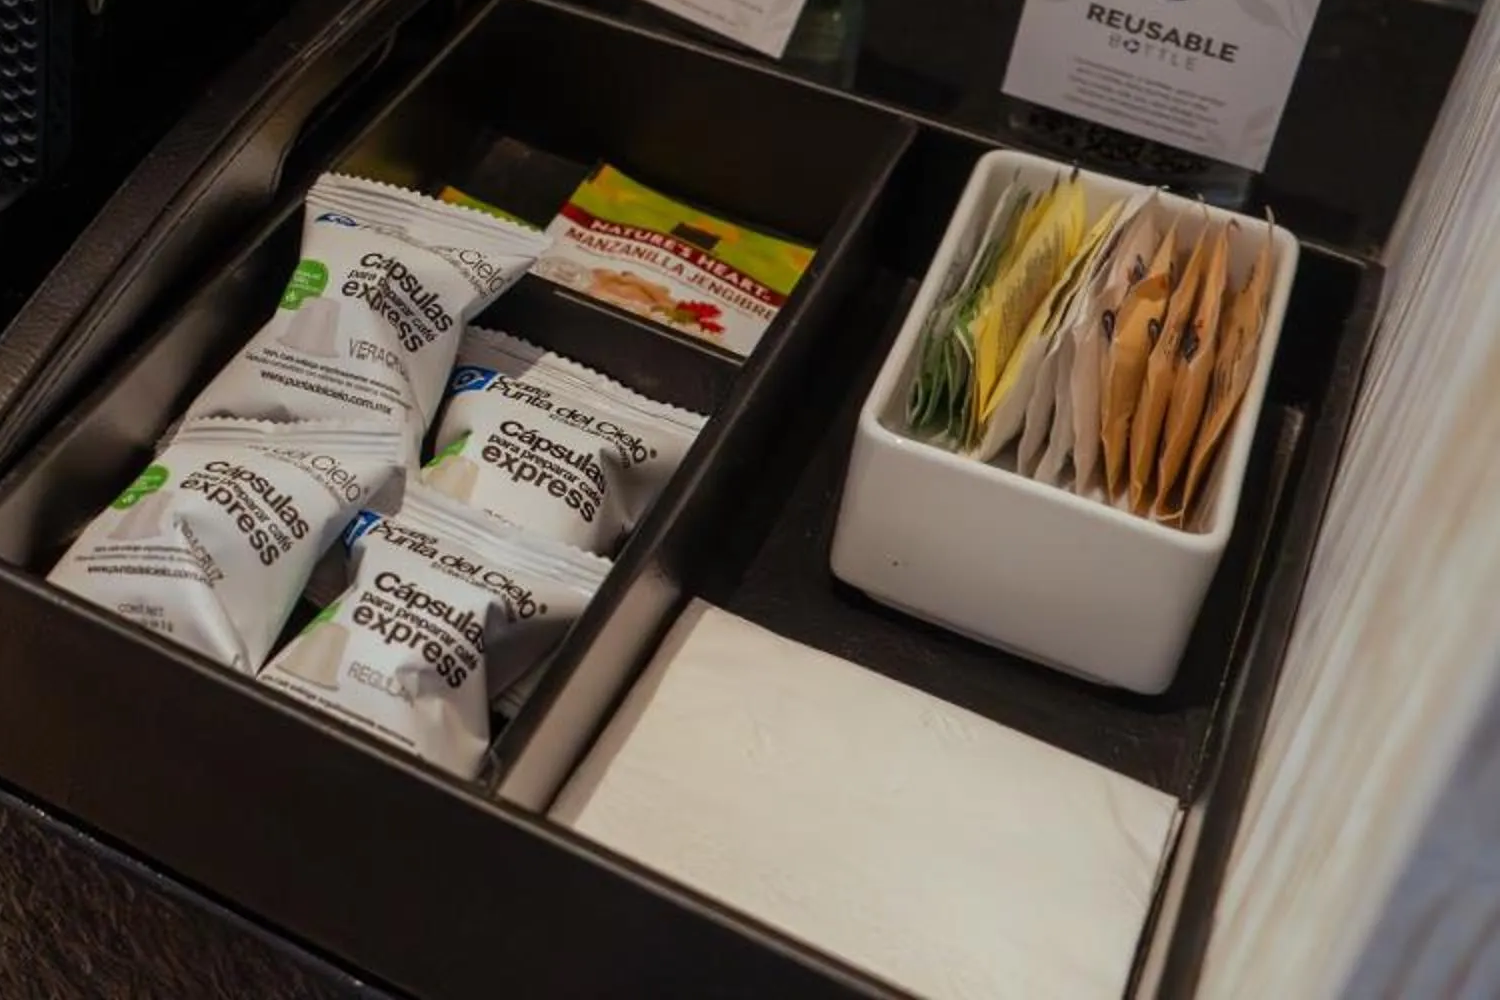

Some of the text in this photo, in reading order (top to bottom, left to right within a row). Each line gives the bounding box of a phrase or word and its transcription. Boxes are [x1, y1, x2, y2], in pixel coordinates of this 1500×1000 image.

[1086, 3, 1239, 63] REUSABLE
[1108, 32, 1197, 73] BOTTLE
[459, 248, 508, 295] Cielo
[564, 227, 774, 321] MANZANILLA JENGIBRE
[590, 220, 768, 297] NATURE'S HEART
[341, 280, 424, 353] express
[488, 434, 521, 454] para
[520, 450, 581, 483] preparar
[556, 407, 595, 425] del
[596, 421, 647, 463] Cielo
[311, 455, 361, 502] Cielo
[481, 445, 595, 523] express
[180, 479, 279, 566] express
[268, 523, 294, 552] café
[440, 555, 482, 574] del
[483, 571, 536, 619] Cielo
[353, 606, 468, 689] express
[361, 591, 396, 613] para
[395, 607, 457, 648] preparar
